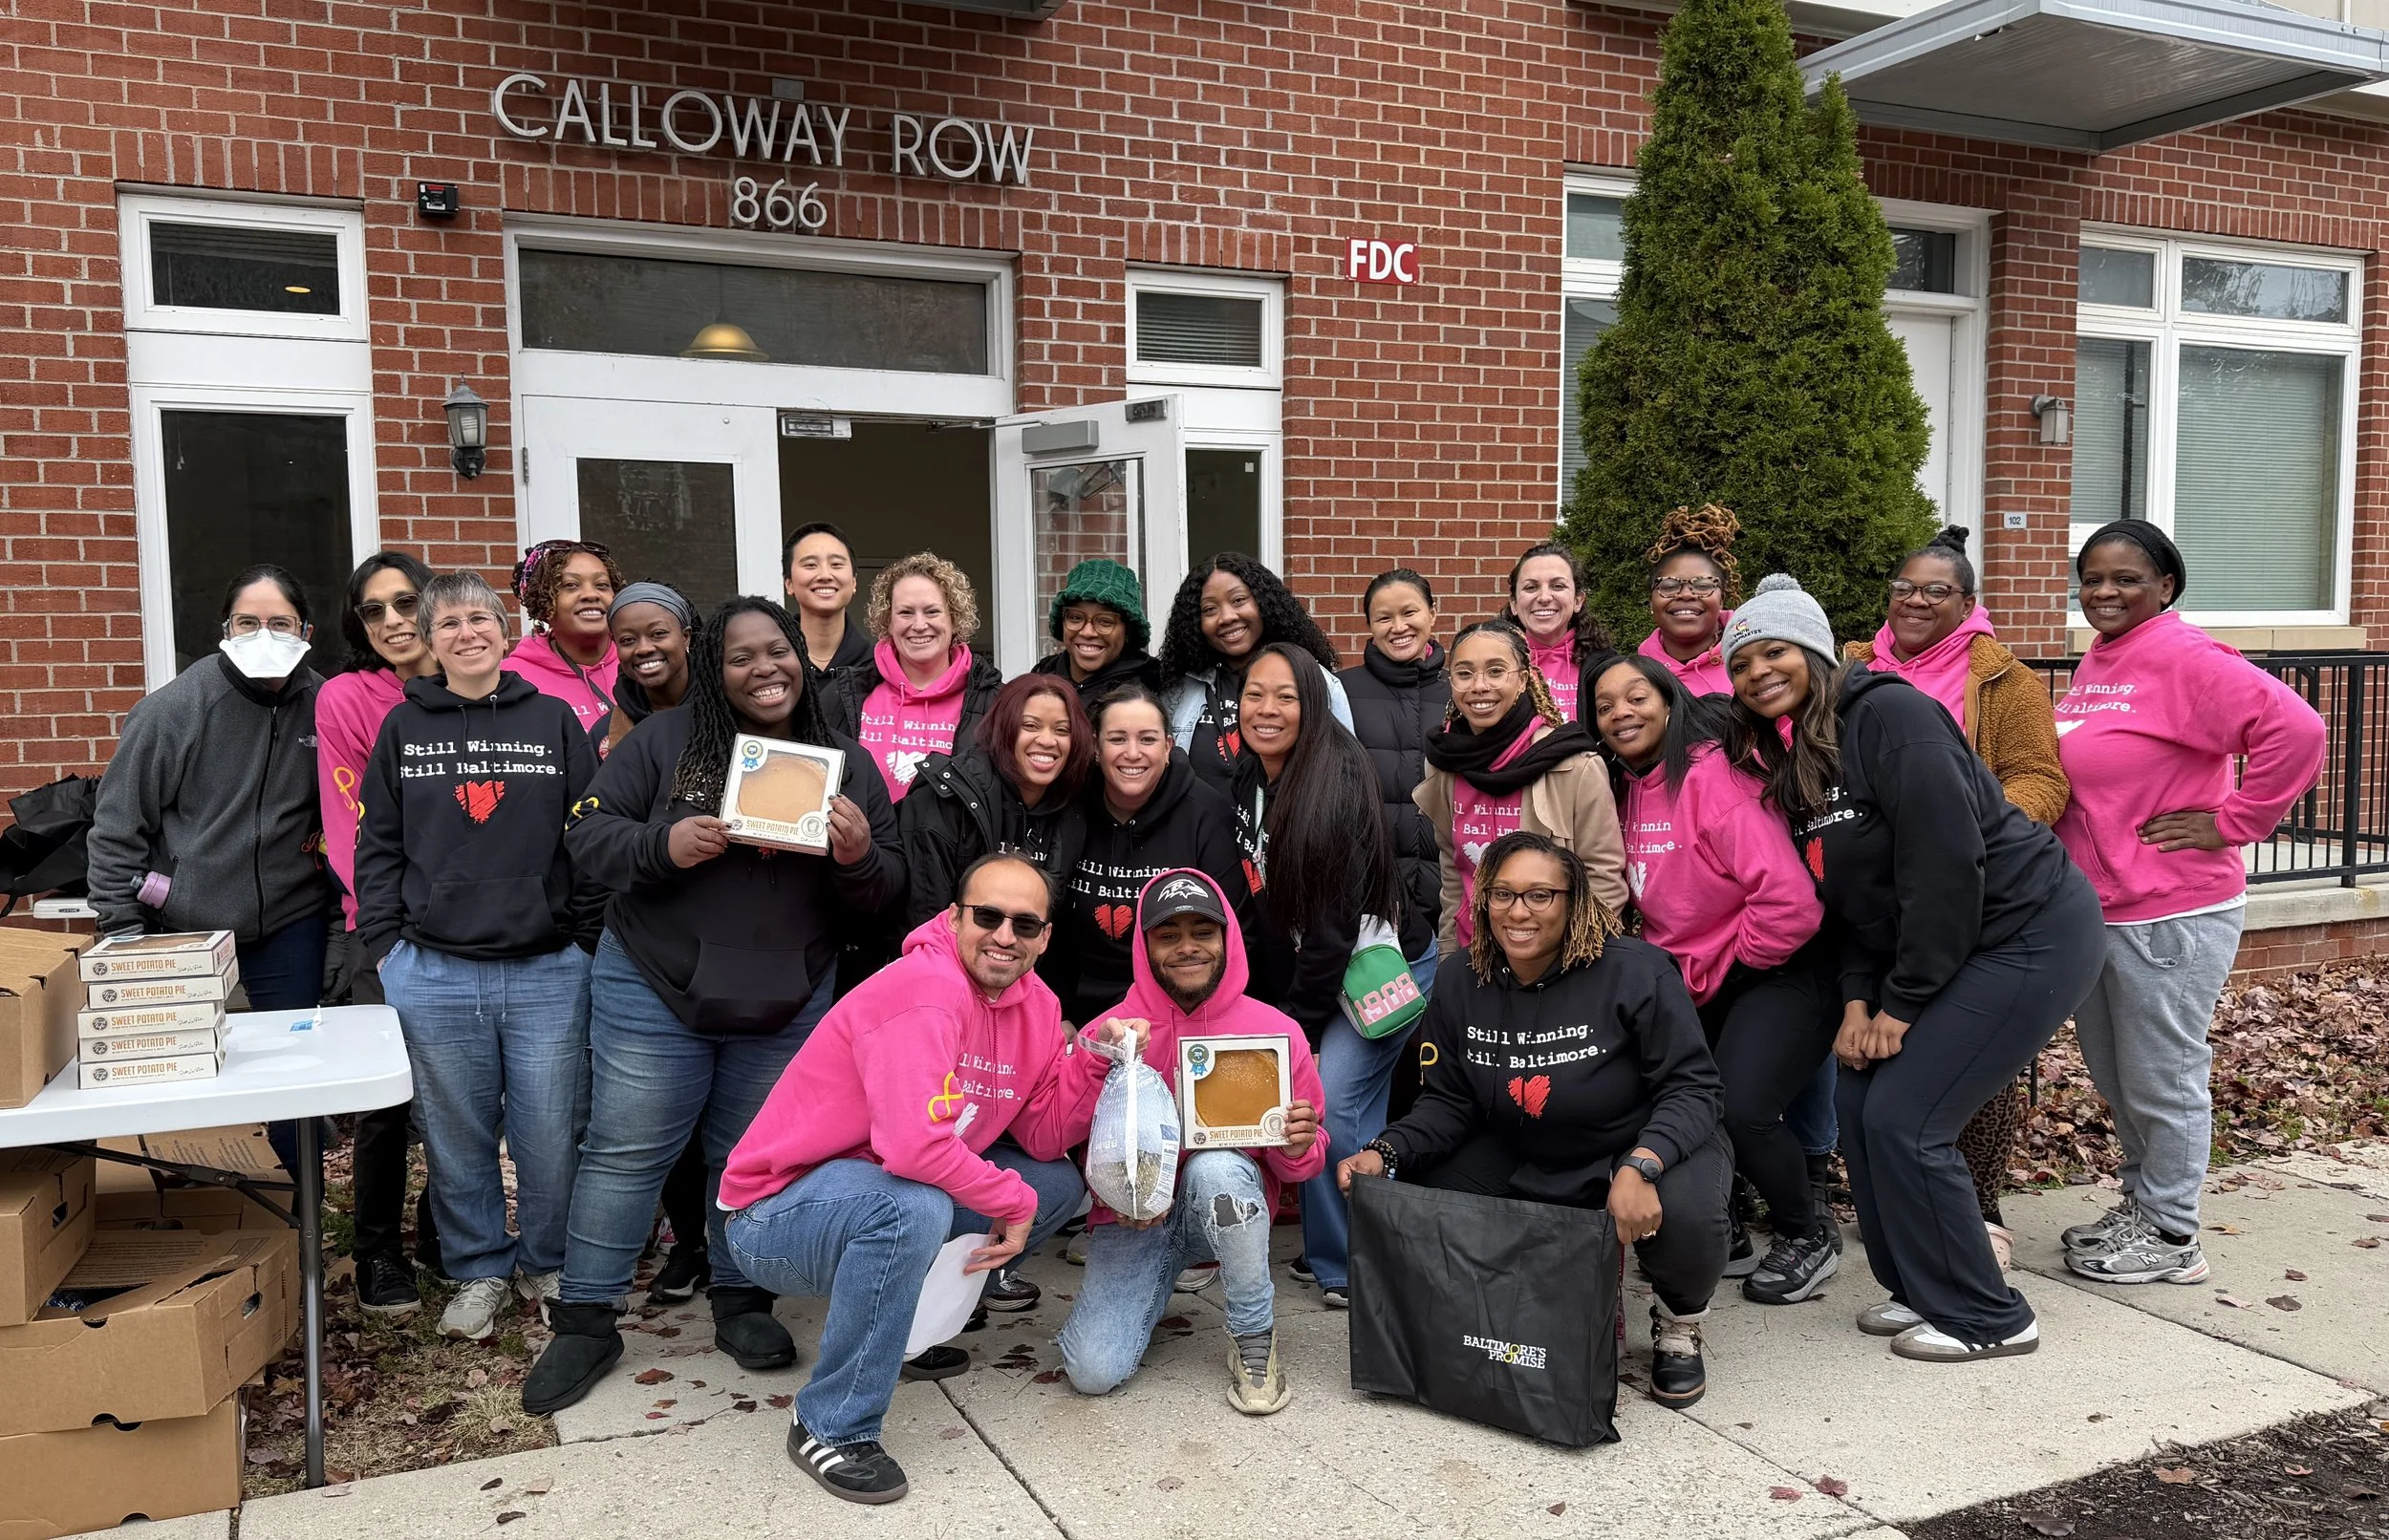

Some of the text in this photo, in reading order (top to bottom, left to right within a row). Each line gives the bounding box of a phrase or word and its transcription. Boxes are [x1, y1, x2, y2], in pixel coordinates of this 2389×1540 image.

[494, 74, 1034, 184] CALLOWAY ROW
[733, 177, 828, 229] 866
[1350, 239, 1414, 282] FDC
[2009, 516, 2021, 524] 102
[903, 720, 956, 732] Winnin
[404, 740, 552, 756] Still Winning.
[891, 734, 954, 750] Baltimo
[457, 761, 564, 776] Baltimore.
[746, 820, 799, 835] SWEET POTATO PIE
[1108, 866, 1170, 878] Winnin
[1098, 886, 1141, 898] Balti
[111, 961, 135, 972] SWEET
[137, 960, 163, 970] POTATO
[165, 959, 177, 968] PIE
[121, 988, 144, 998] SWEET
[146, 986, 173, 996] POTATO
[175, 985, 186, 995] PIE
[1354, 973, 1420, 1026] 1908
[112, 1016, 135, 1026] SWEET
[137, 1014, 164, 1023] POTATO
[166, 1012, 177, 1022] PIE
[1467, 1026, 1511, 1045] Still
[112, 1039, 135, 1050] SWEET
[137, 1037, 164, 1048] POTATO
[166, 1037, 177, 1046] PIE
[1510, 1045, 1606, 1068] Baltimore.
[112, 1065, 135, 1076] SWEET
[137, 1063, 164, 1074] POTATO
[166, 1062, 177, 1072] PIE
[1210, 1130, 1230, 1139] SWEET
[1230, 1129, 1253, 1138] POTATO
[1254, 1128, 1263, 1137] PIE
[1463, 1335, 1546, 1358] BALTIMORE'S
[1489, 1350, 1545, 1369] PROMISE
